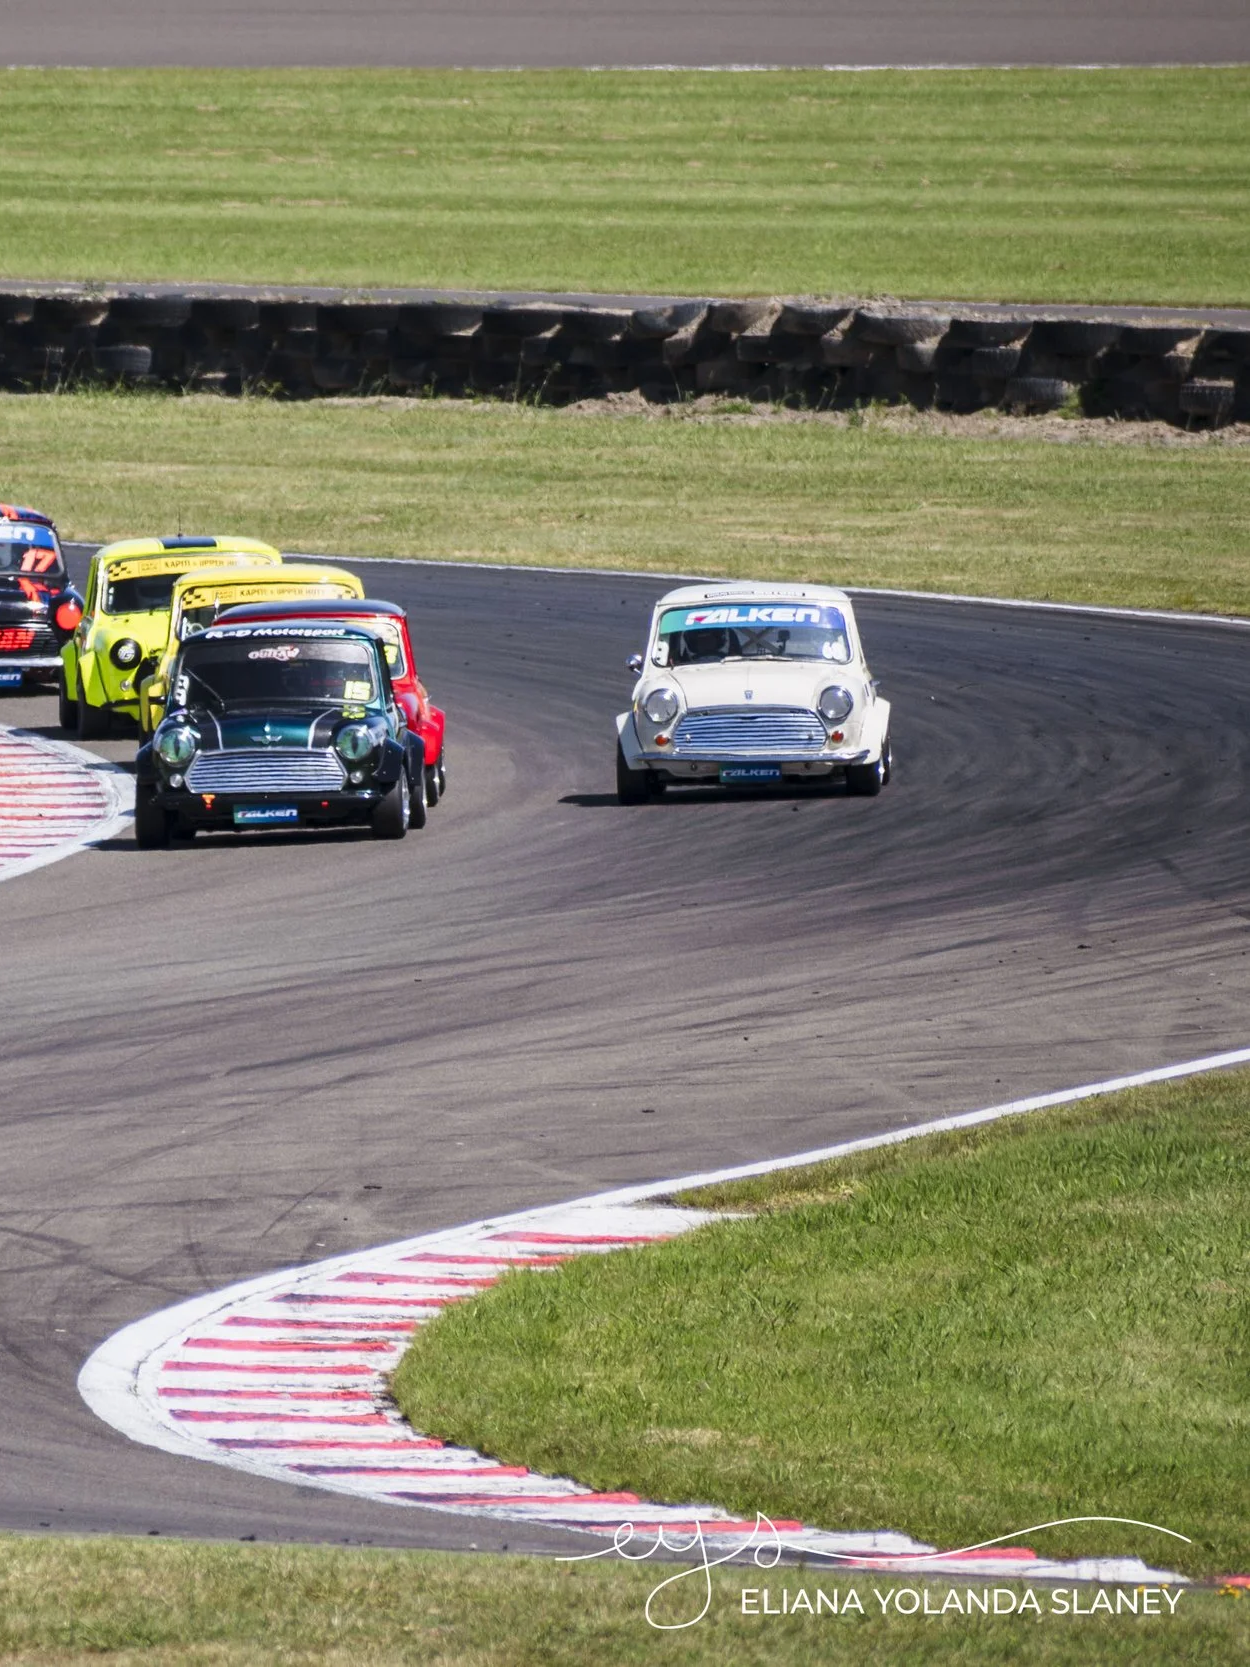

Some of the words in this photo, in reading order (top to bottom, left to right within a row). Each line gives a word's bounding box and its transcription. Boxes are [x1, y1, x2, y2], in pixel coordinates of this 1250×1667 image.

[20, 548, 57, 573] 17
[685, 607, 821, 626] FALKEN
[722, 769, 780, 777] FALKEN
[237, 808, 298, 818] FALKEN
